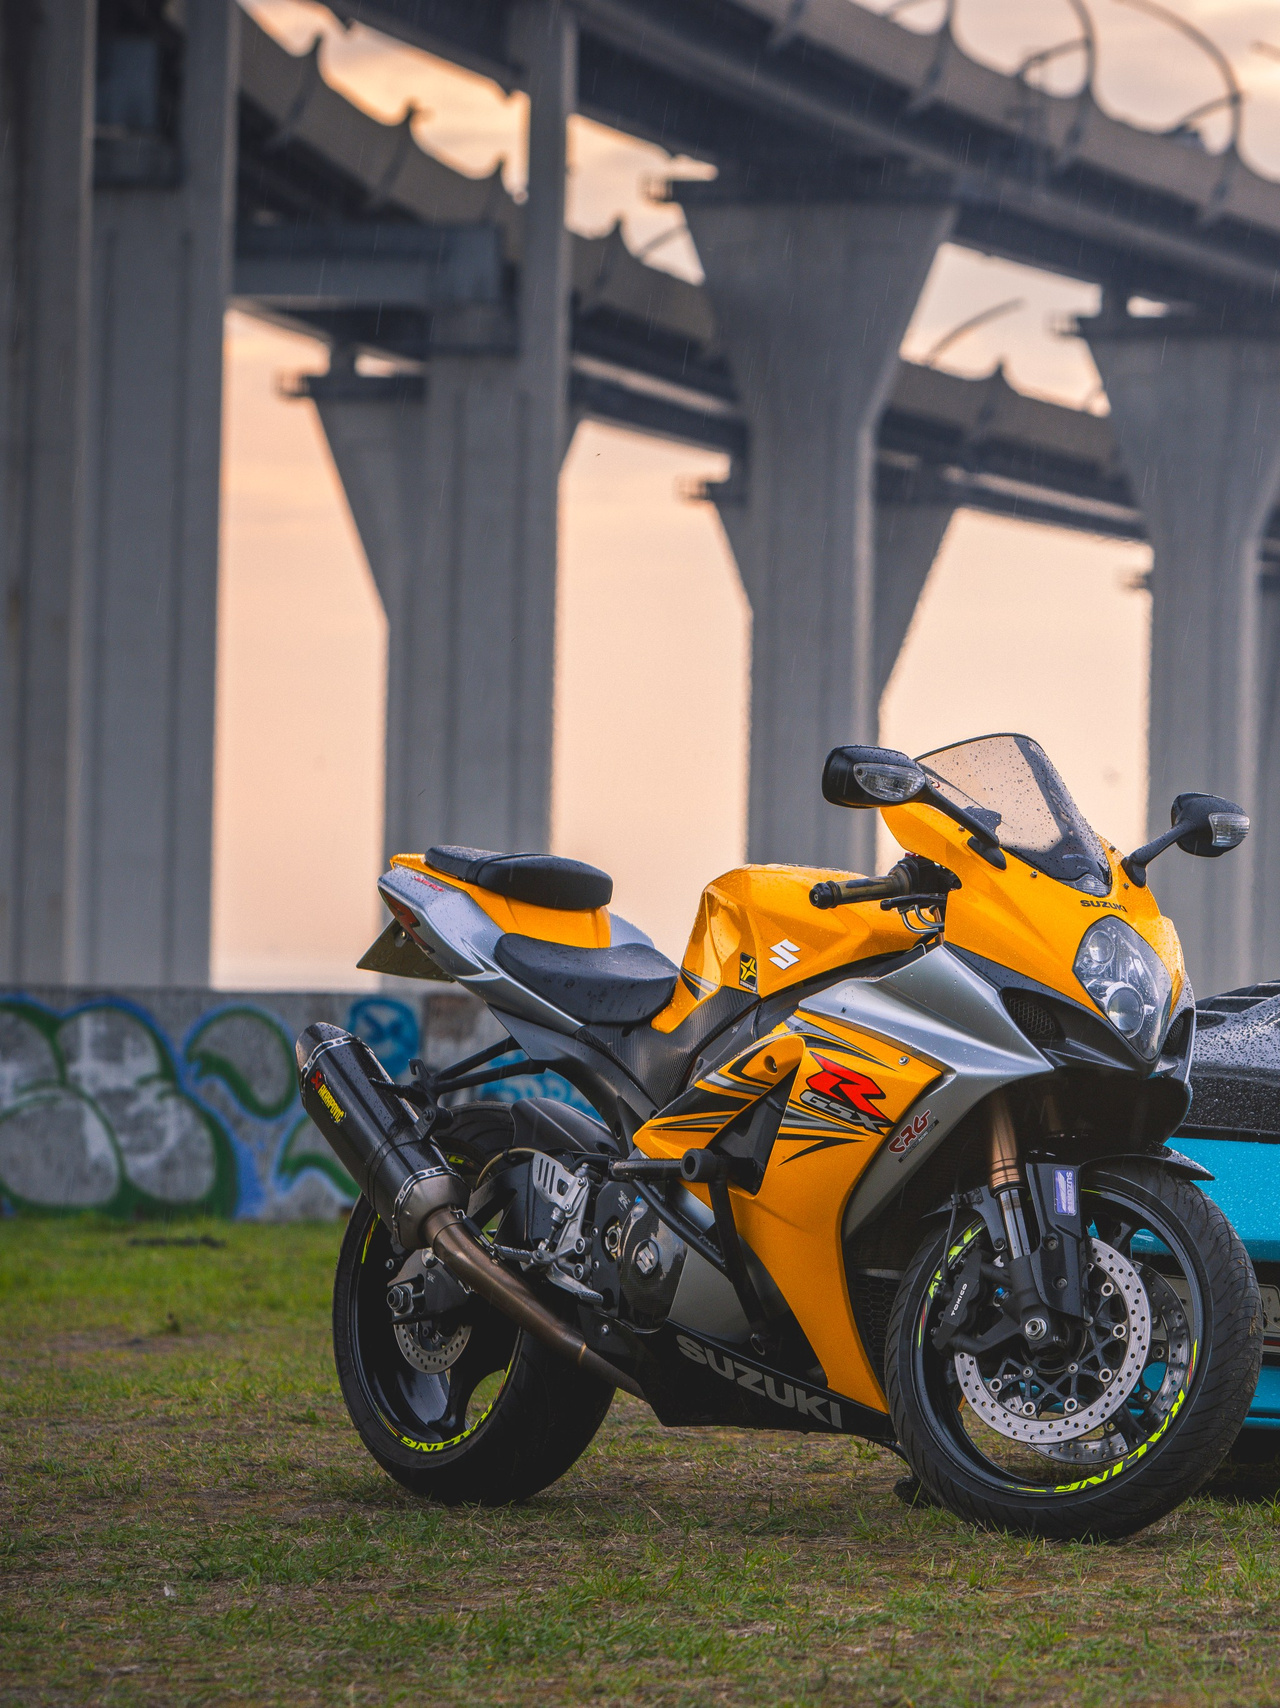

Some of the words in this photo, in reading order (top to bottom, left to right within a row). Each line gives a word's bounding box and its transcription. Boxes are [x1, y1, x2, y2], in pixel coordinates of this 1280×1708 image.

[1080, 899, 1128, 912] SUZUKI
[800, 1089, 887, 1133] GSX
[888, 1109, 931, 1154] CRG
[951, 1283, 968, 1317] TOKICO
[676, 1334, 843, 1429] SUZUKI
[1054, 1389, 1186, 1493] RACING
